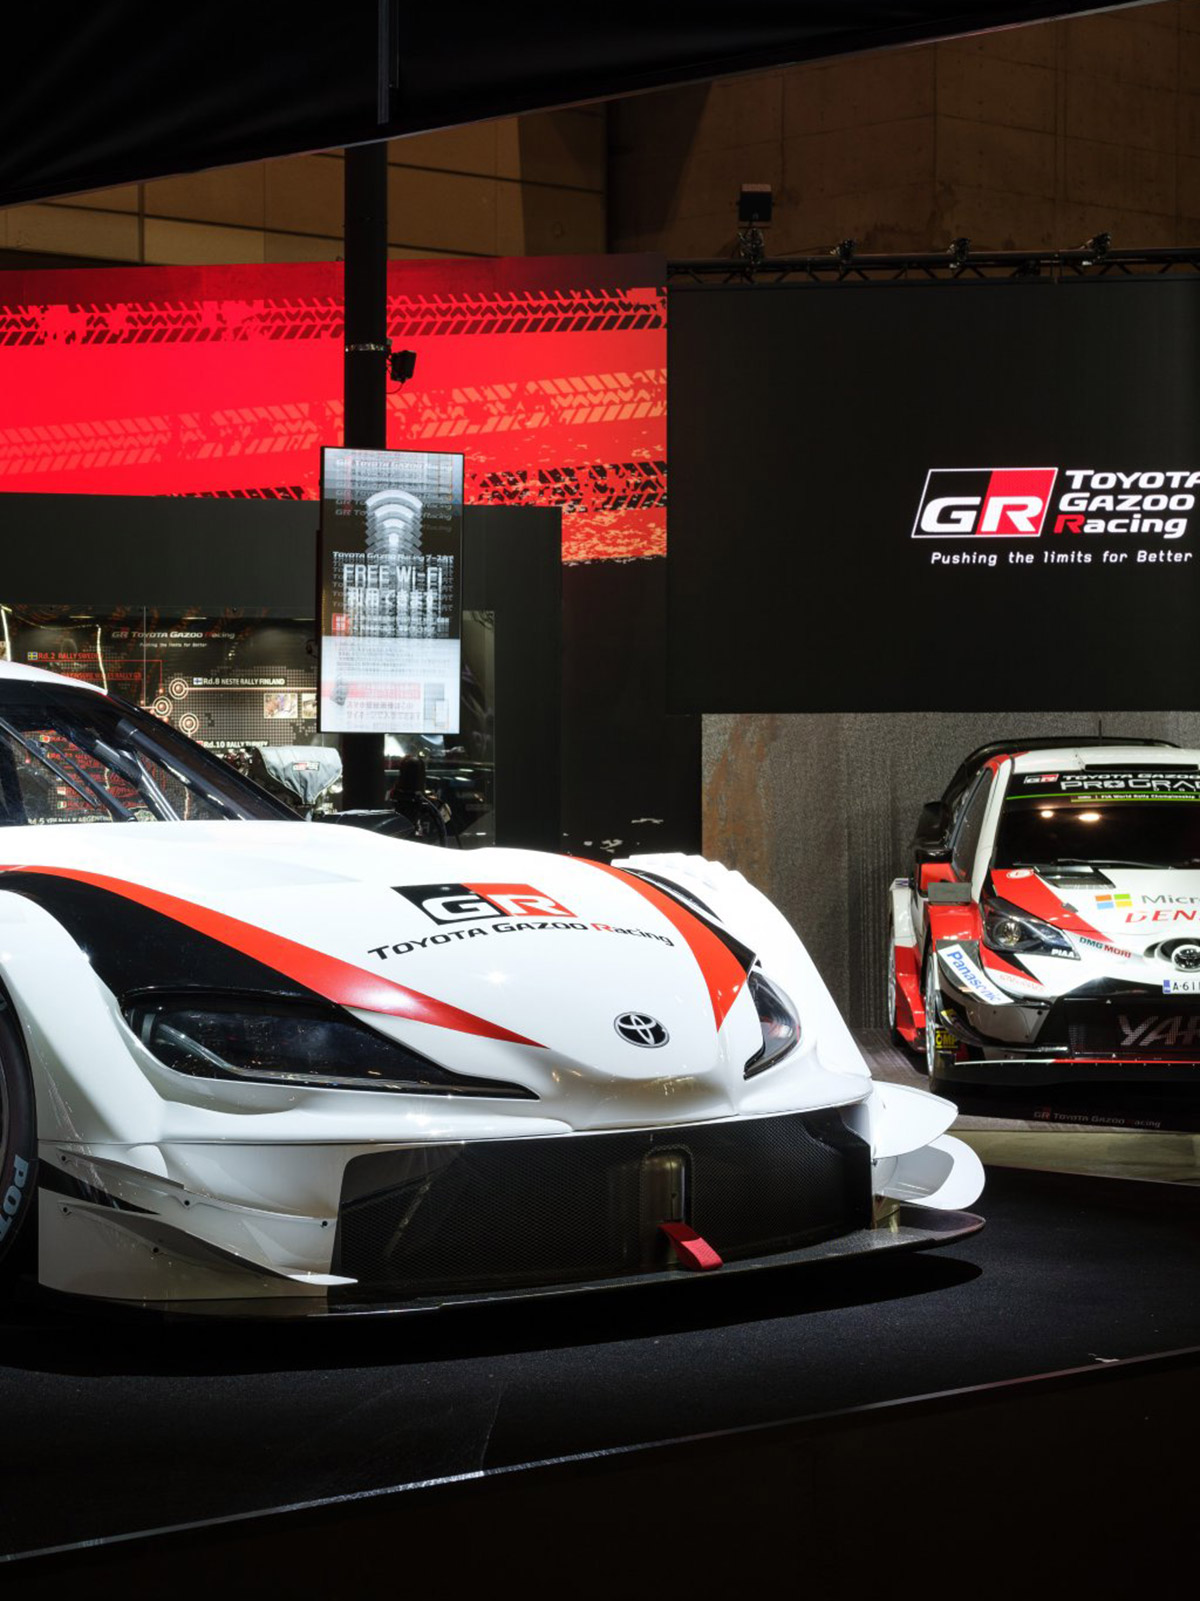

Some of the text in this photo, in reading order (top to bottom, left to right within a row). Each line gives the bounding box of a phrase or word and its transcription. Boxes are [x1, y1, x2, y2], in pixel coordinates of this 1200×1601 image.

[1065, 469, 1200, 490] TOYOTA
[1058, 491, 1195, 512] GAZOO
[919, 495, 1044, 533] GR
[1053, 513, 1188, 539] Racing
[332, 551, 366, 559] TOYOTA
[931, 550, 1193, 567] Pushing the limits for Better
[343, 564, 391, 583] FREE
[131, 631, 168, 639] TOYOTA
[169, 631, 203, 639] GAZOO
[203, 741, 226, 749] Rd.10
[419, 893, 567, 921] GR
[1125, 910, 1200, 923] DEN
[367, 921, 675, 960] TOYOTA GAZOO Racing
[1079, 936, 1132, 959] DMG MORI
[1051, 948, 1076, 958] PIAA
[946, 950, 1002, 1002] Panasonic
[1053, 1112, 1089, 1122] TOYOTA
[1091, 1115, 1125, 1126] GAZOO
